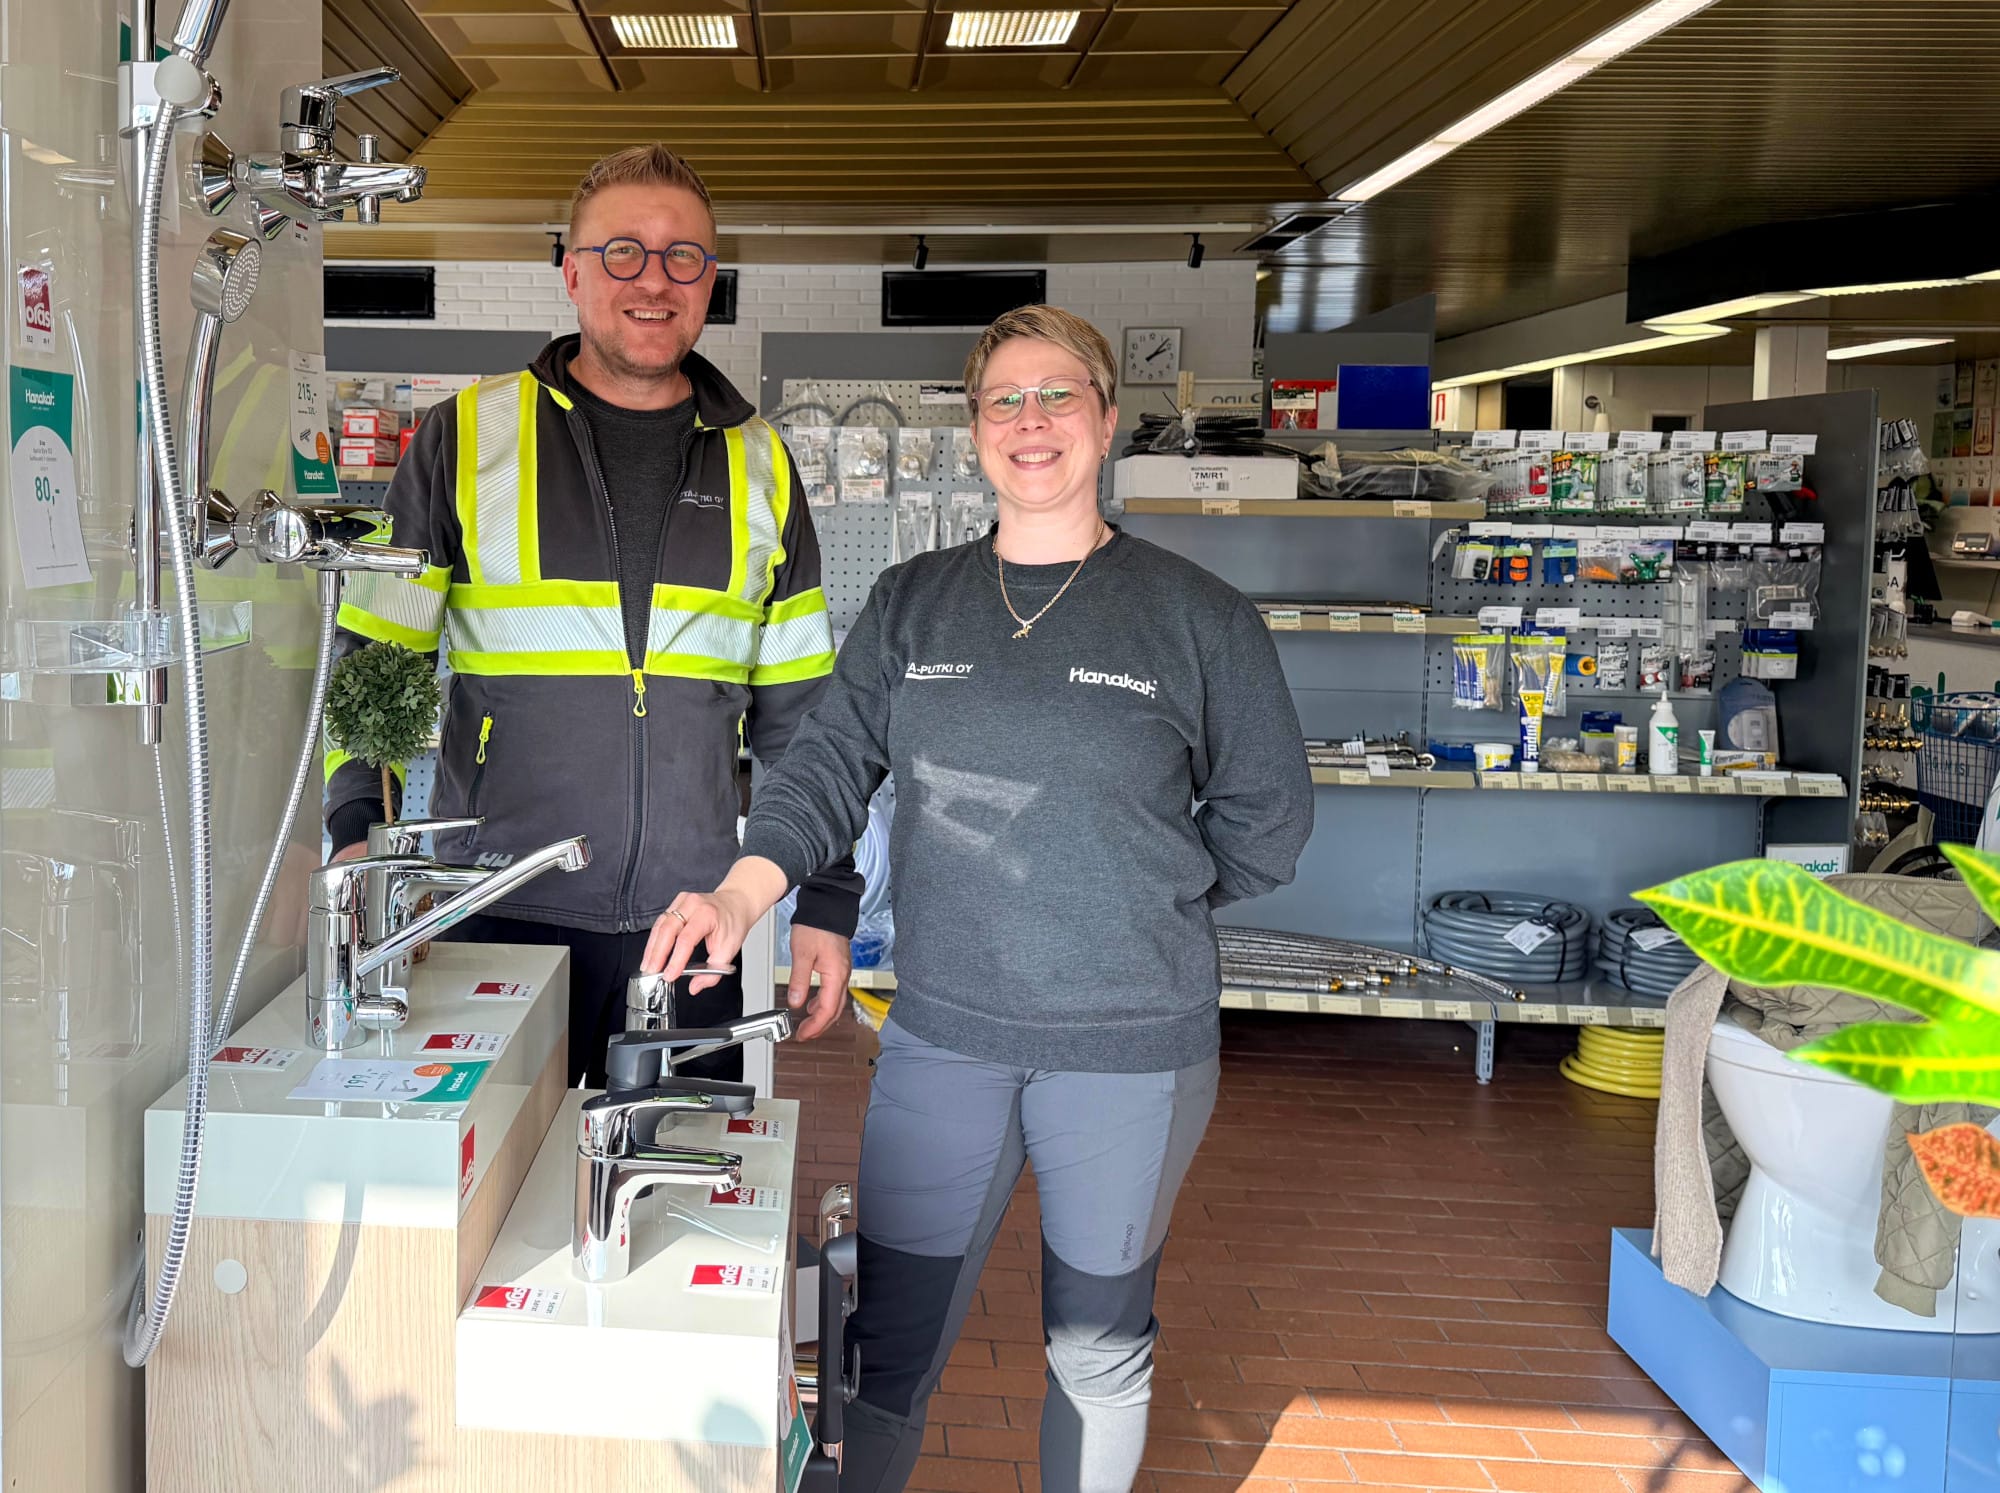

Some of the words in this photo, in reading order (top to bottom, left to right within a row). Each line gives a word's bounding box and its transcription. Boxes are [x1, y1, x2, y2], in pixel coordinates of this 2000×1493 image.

[26, 302, 51, 328] oras
[1194, 471, 1224, 480] 7M/R1
[35, 476, 60, 505] 80,-
[955, 662, 973, 675] OY
[734, 1187, 753, 1205] oras
[718, 1264, 739, 1285] oras
[504, 1287, 527, 1309] oras
